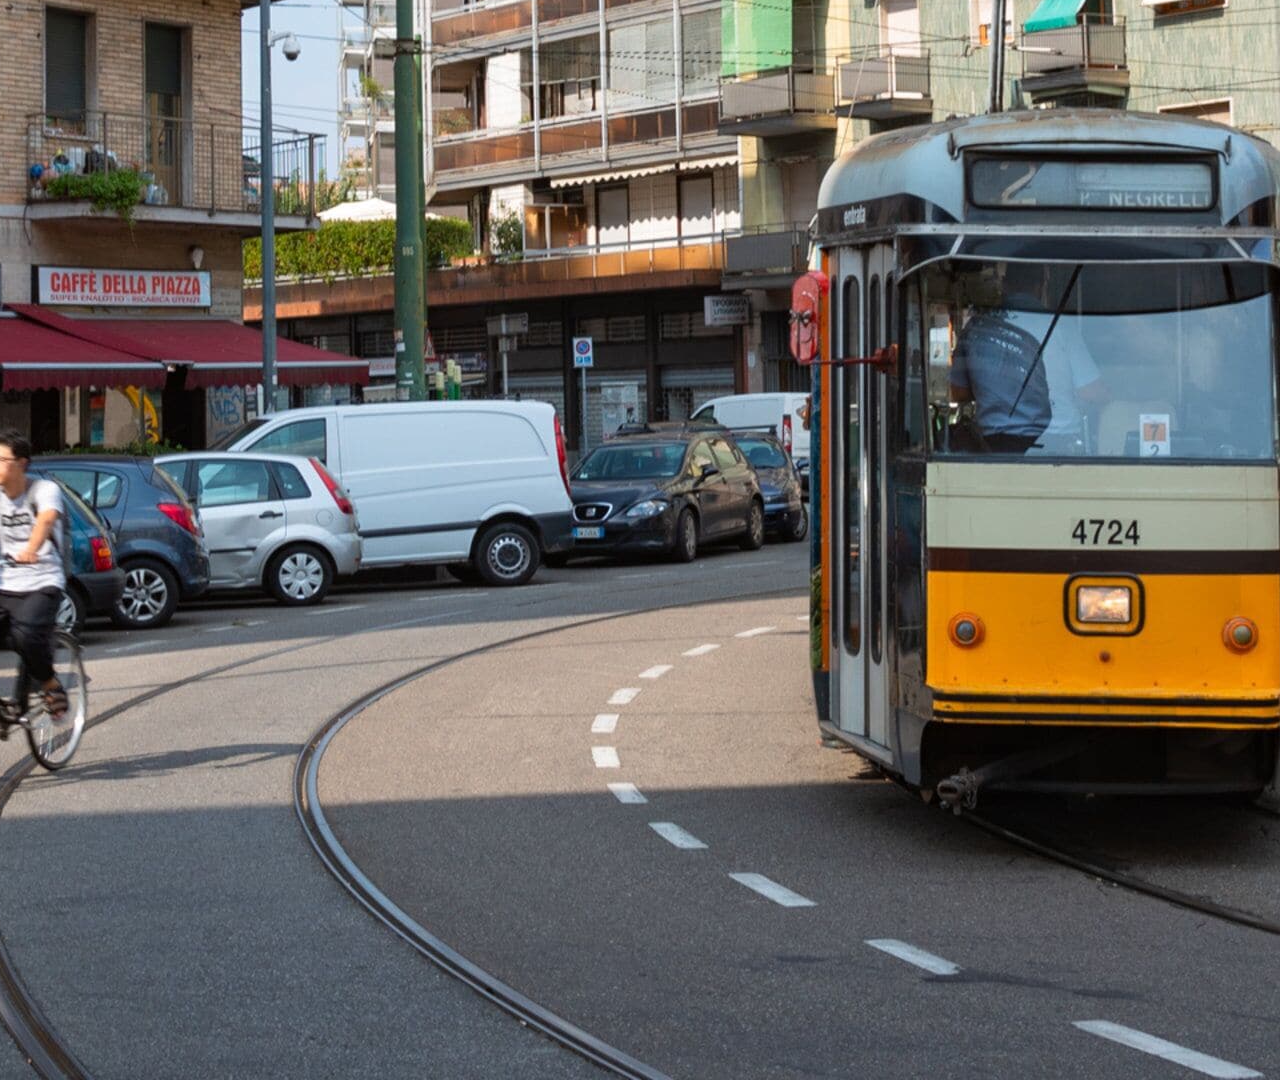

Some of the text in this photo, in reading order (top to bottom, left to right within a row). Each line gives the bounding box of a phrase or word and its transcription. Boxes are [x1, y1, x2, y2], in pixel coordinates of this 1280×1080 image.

[50, 270, 200, 296] CAFFÈ DELLA PIAZZA
[1072, 519, 1140, 545] 4724
